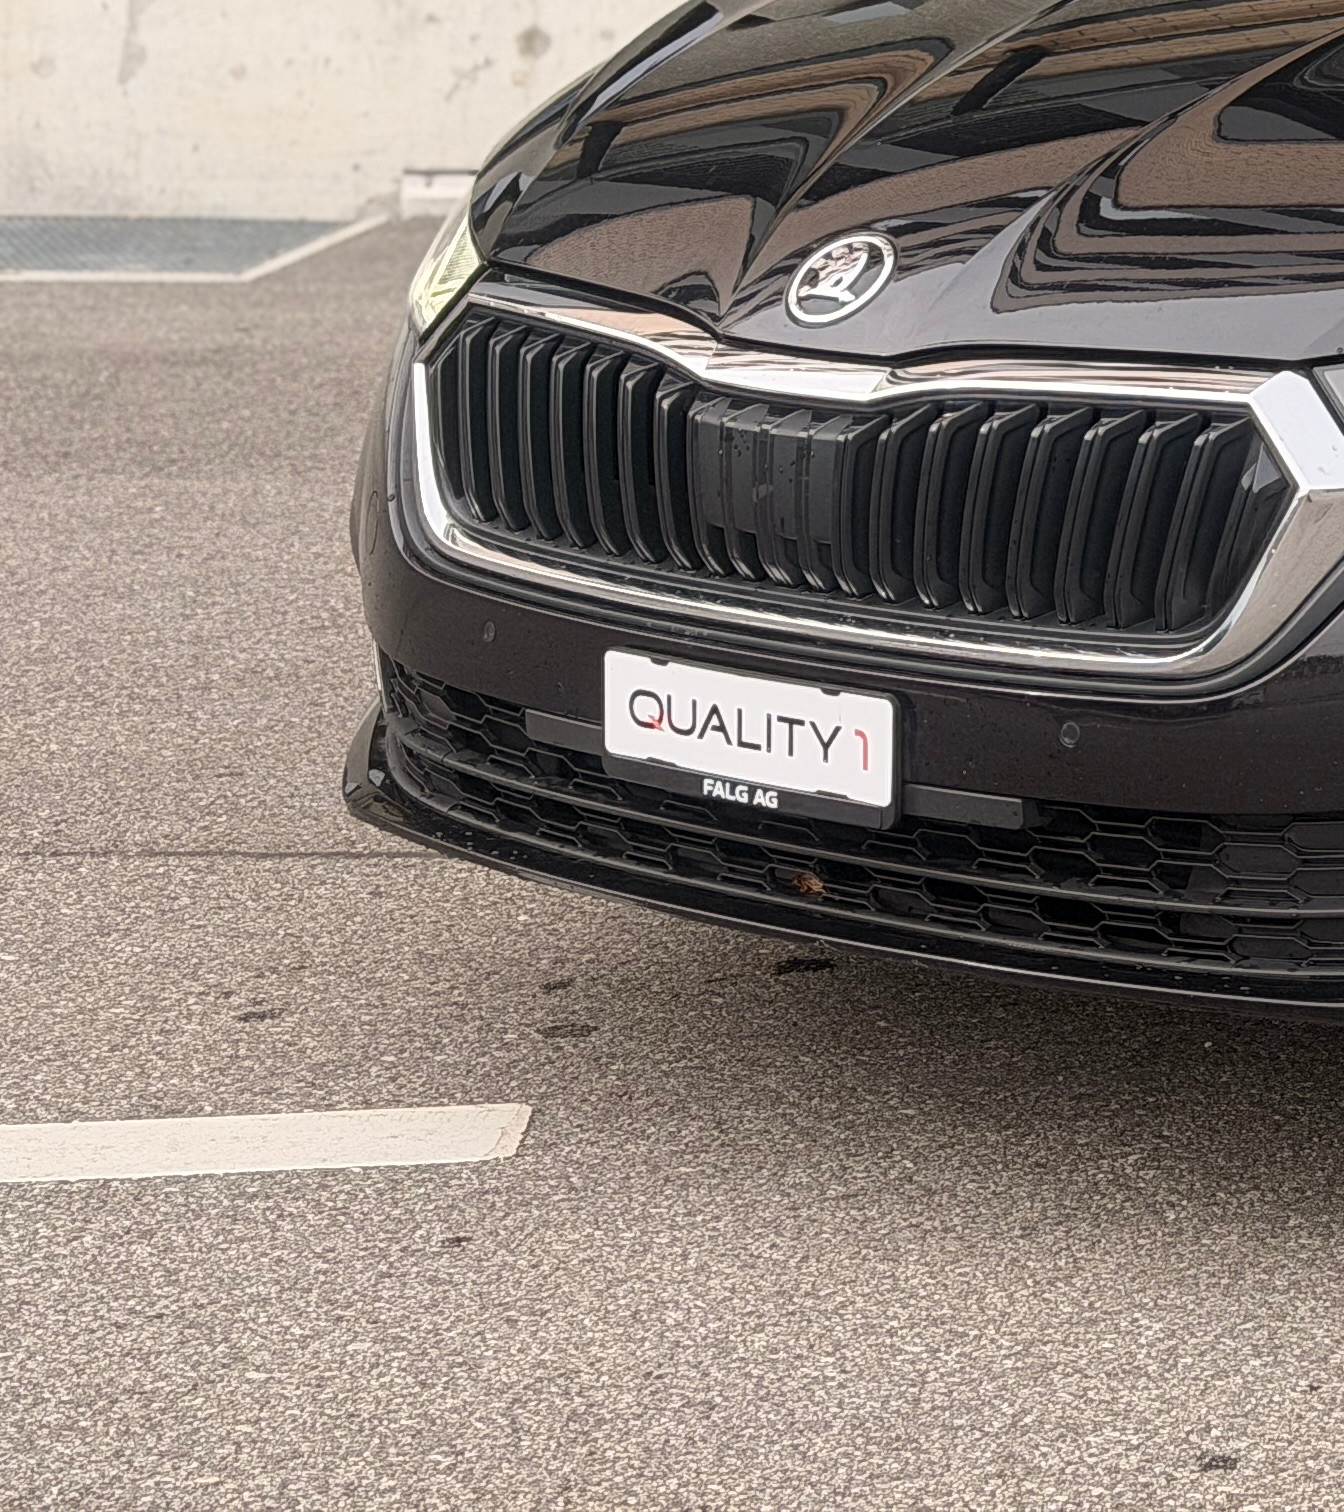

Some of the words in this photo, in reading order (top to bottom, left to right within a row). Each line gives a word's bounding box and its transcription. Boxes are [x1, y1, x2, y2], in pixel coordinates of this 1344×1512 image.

[628, 688, 842, 763] QUALITY
[854, 729, 869, 771] 1
[702, 778, 749, 802] FALG
[753, 789, 779, 809] AG
